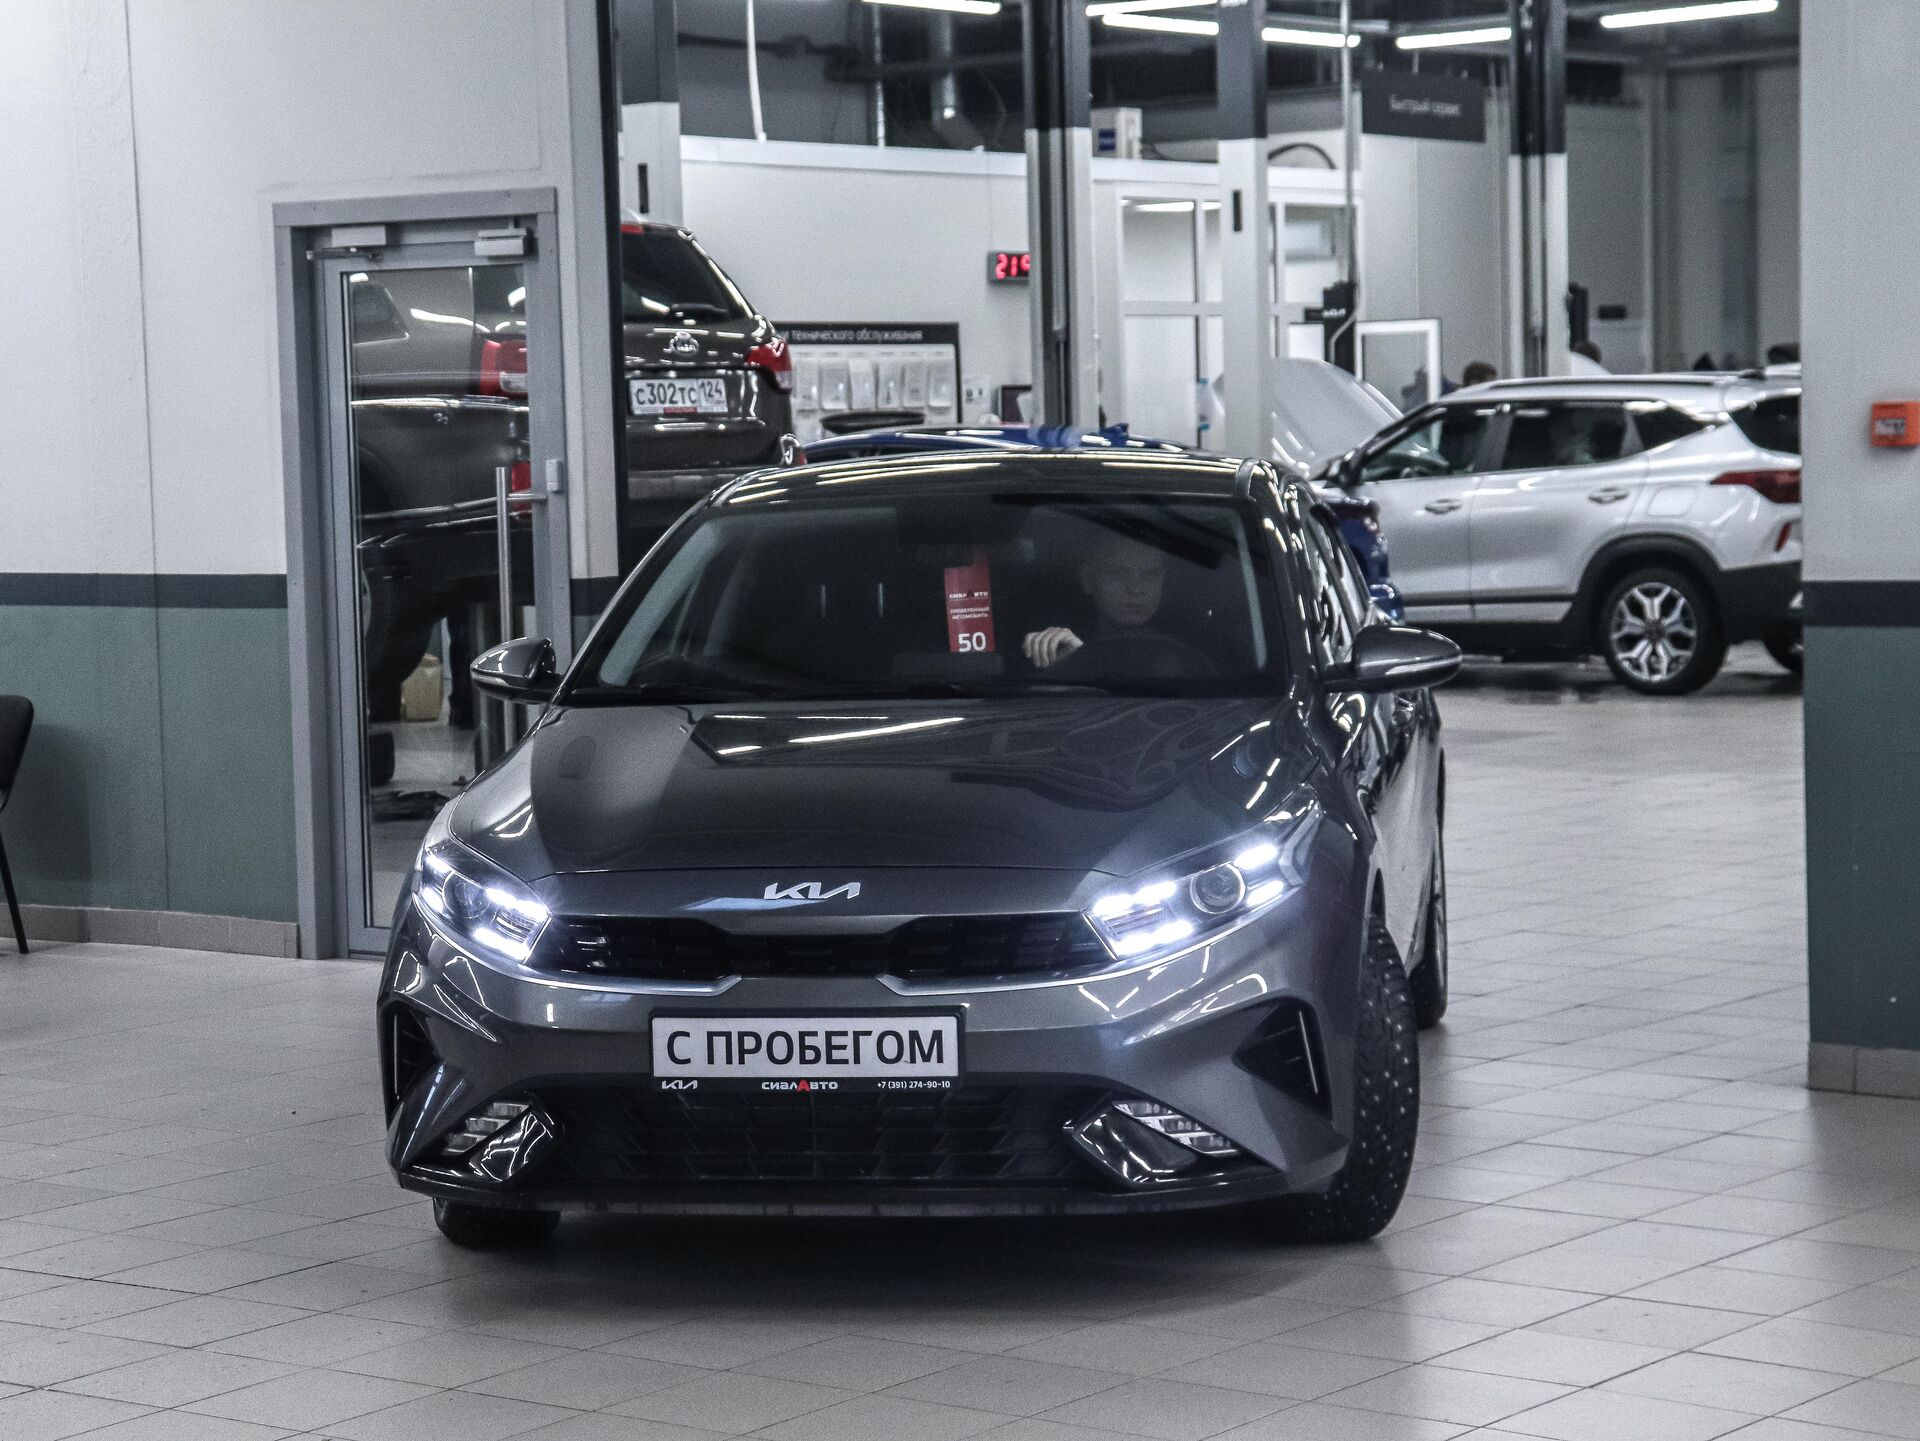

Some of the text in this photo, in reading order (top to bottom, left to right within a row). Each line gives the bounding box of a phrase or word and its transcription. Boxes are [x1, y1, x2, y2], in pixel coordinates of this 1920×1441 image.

[636, 381, 723, 405] С302ТС 124
[958, 631, 987, 652] 50
[763, 882, 861, 900] KIA
[667, 1029, 944, 1065] С ПРОБЕГОМ
[661, 1080, 698, 1090] KIA
[877, 1080, 951, 1090] +7 (391) 274-90-10
